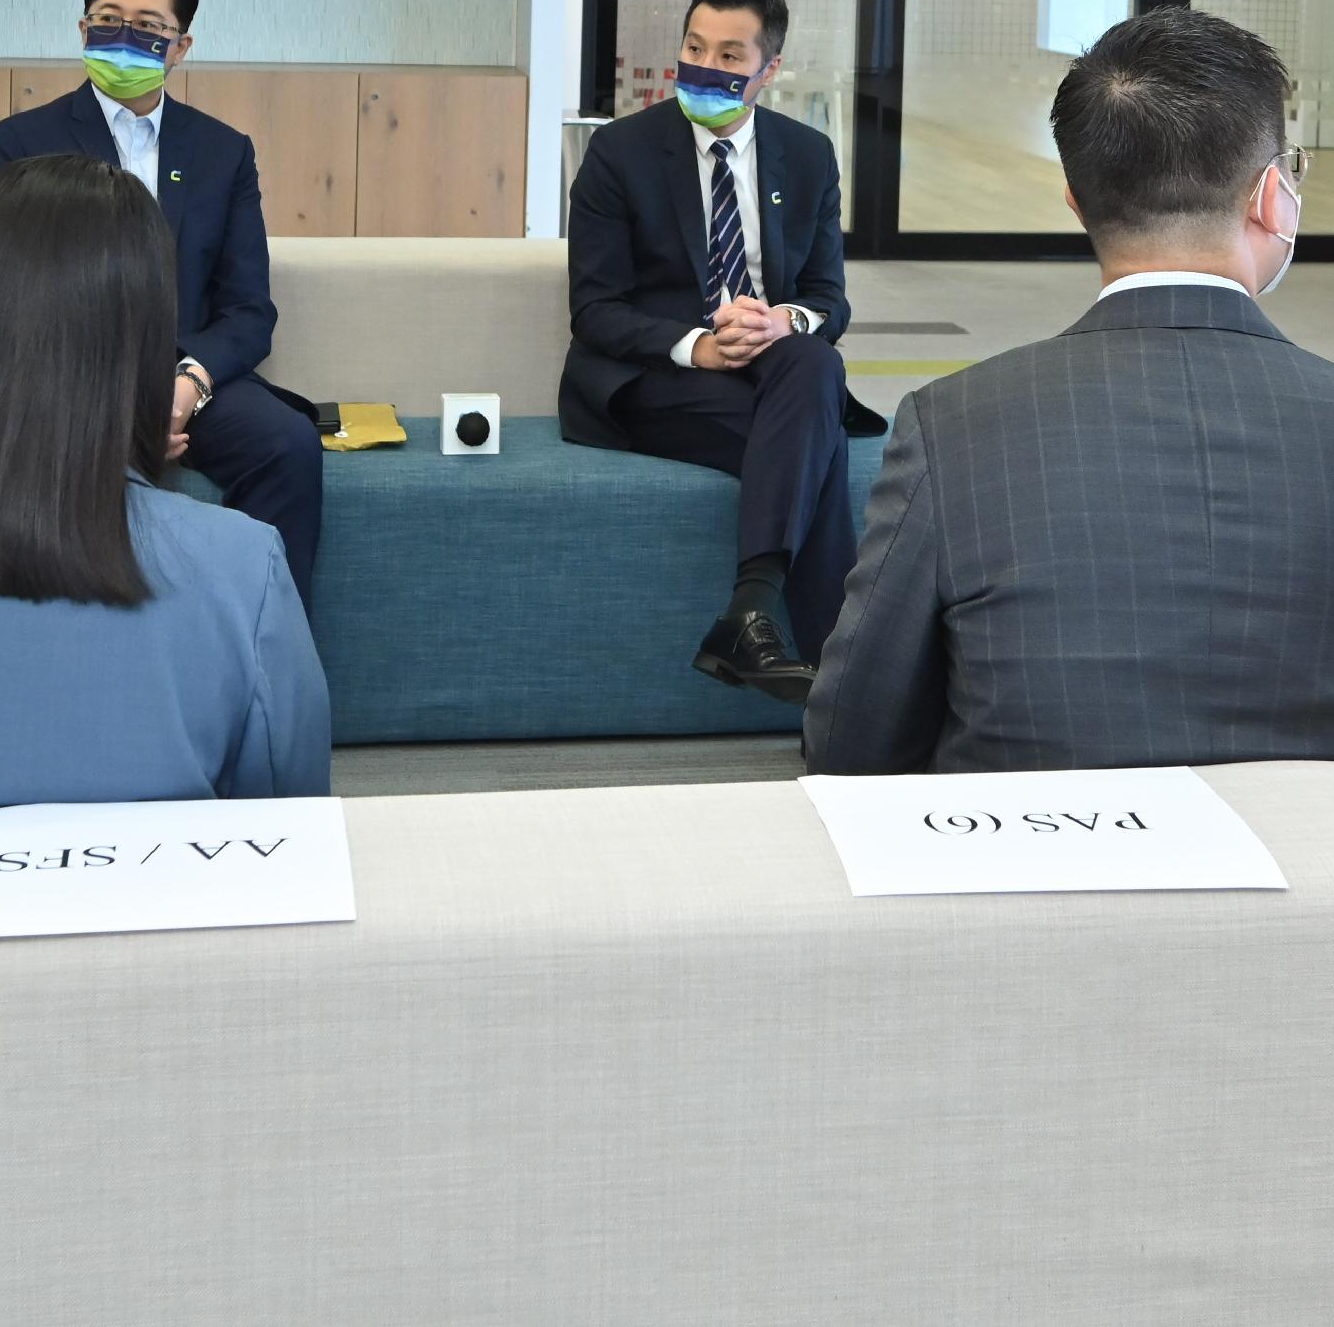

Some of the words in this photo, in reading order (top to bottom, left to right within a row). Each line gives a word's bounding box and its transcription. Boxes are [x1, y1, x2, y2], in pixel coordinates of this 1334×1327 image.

[923, 809, 1002, 835] (6)
[1021, 811, 1155, 833] PAS
[139, 842, 162, 865] /
[185, 837, 291, 861] AA
